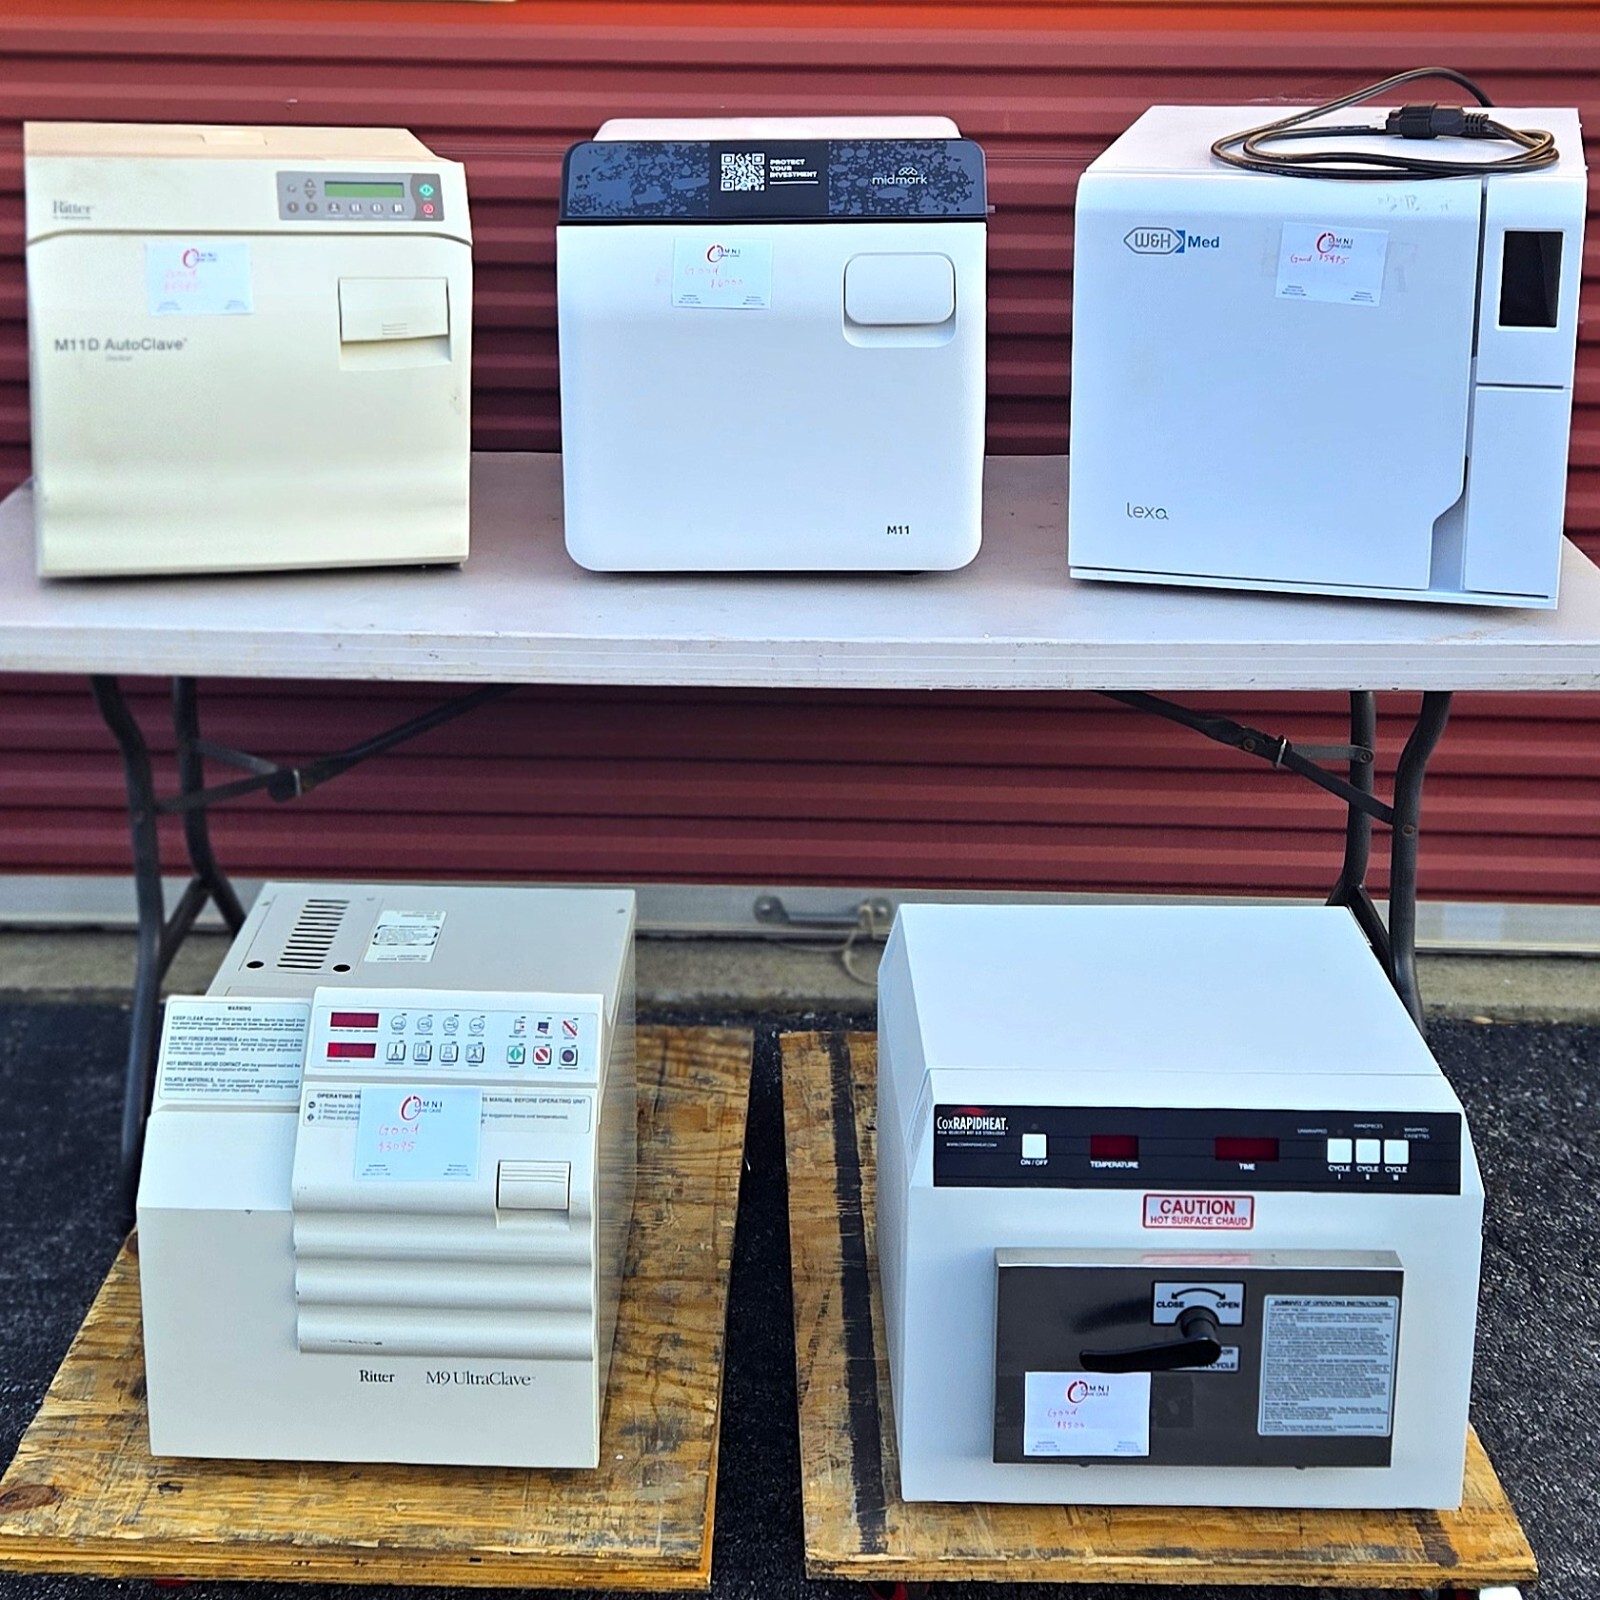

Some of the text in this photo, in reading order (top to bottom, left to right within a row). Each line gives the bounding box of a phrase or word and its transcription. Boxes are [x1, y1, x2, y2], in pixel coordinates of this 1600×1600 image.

[872, 174, 928, 185] midmark
[1134, 232, 1220, 249] W&H Med
[54, 337, 100, 351] M11D
[1126, 501, 1170, 521] lexa
[886, 525, 910, 535] M11
[538, 1097, 572, 1105] OPERATING
[379, 1123, 420, 1136] Good
[1090, 1160, 1140, 1169] TEMPERATURE
[1238, 1162, 1256, 1171] TIME
[1356, 1165, 1380, 1173] CYCLE
[1160, 1200, 1236, 1215] CAUTION
[1150, 1216, 1248, 1226] HOT SURFACE CHAUD
[1216, 1301, 1240, 1309] OPEN
[359, 1369, 395, 1383] Ritter
[426, 1370, 451, 1386] M9
